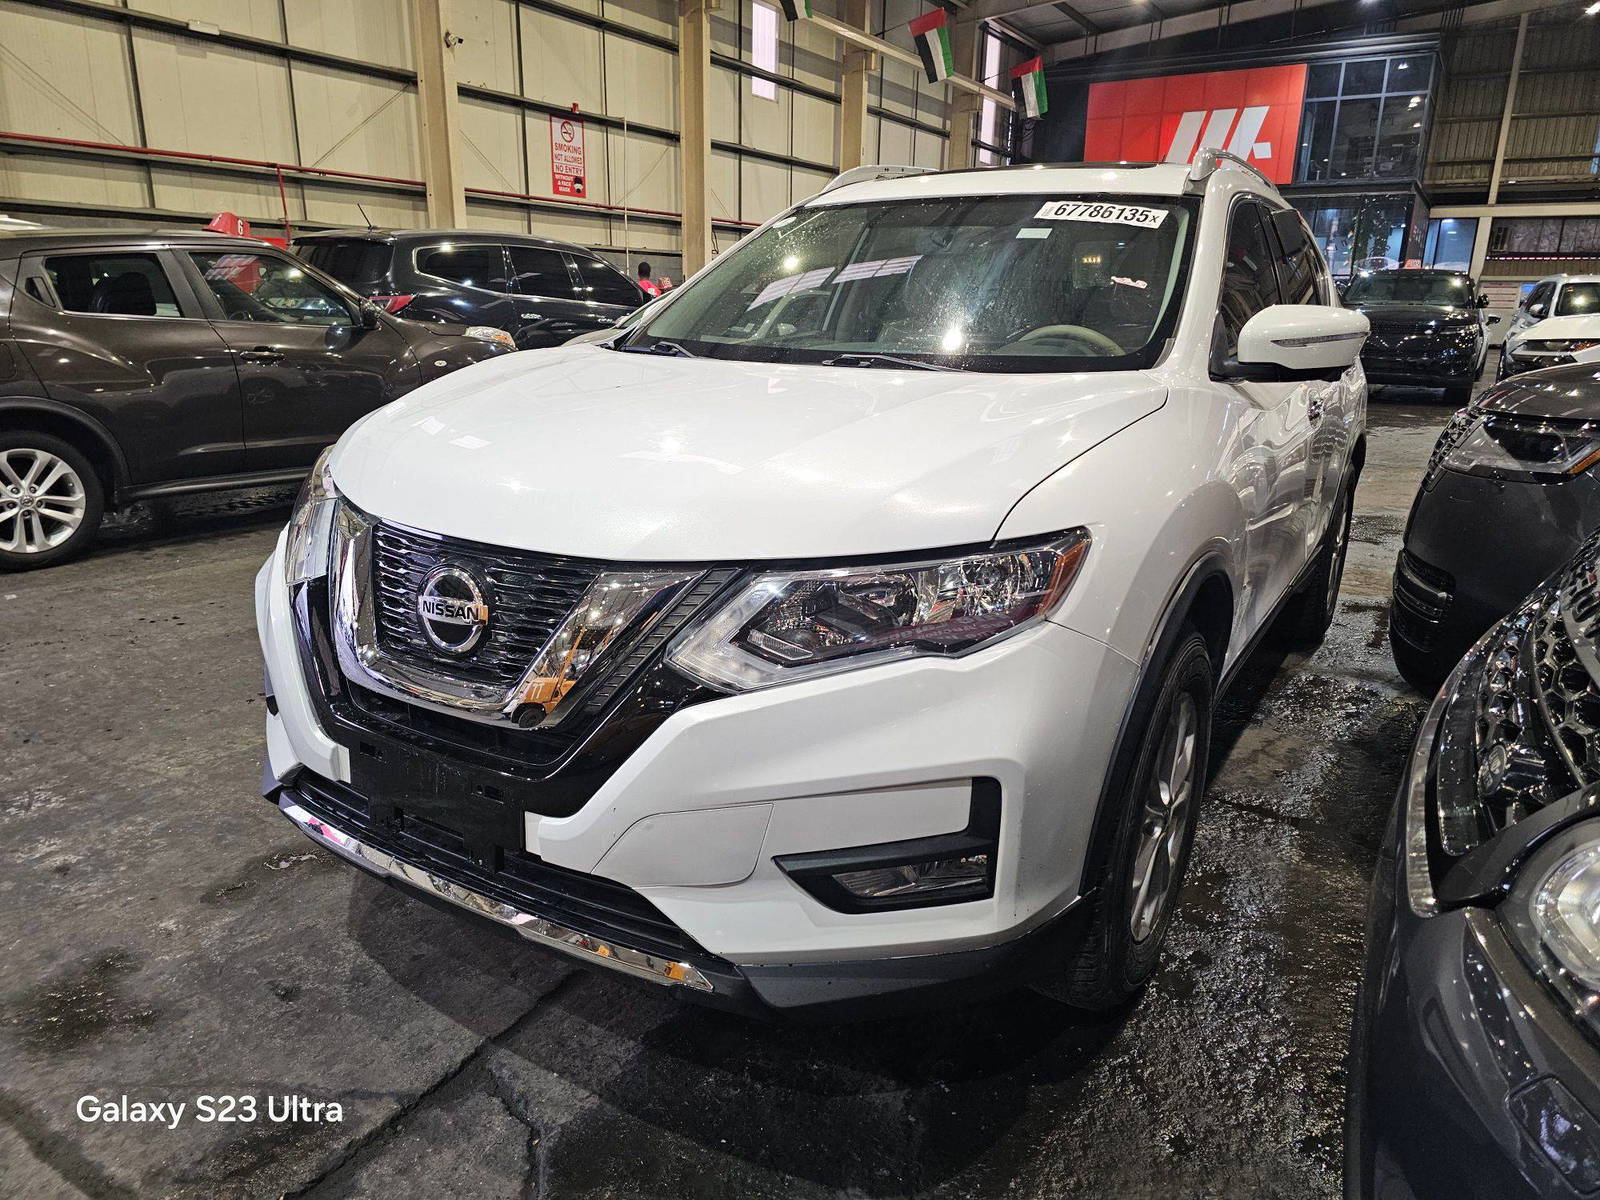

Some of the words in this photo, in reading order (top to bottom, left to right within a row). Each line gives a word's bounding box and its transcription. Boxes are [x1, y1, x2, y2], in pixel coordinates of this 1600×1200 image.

[554, 142, 582, 155] SMOKING
[555, 164, 564, 172] NO
[565, 165, 583, 176] ENTRY
[422, 600, 479, 621] NISSAN
